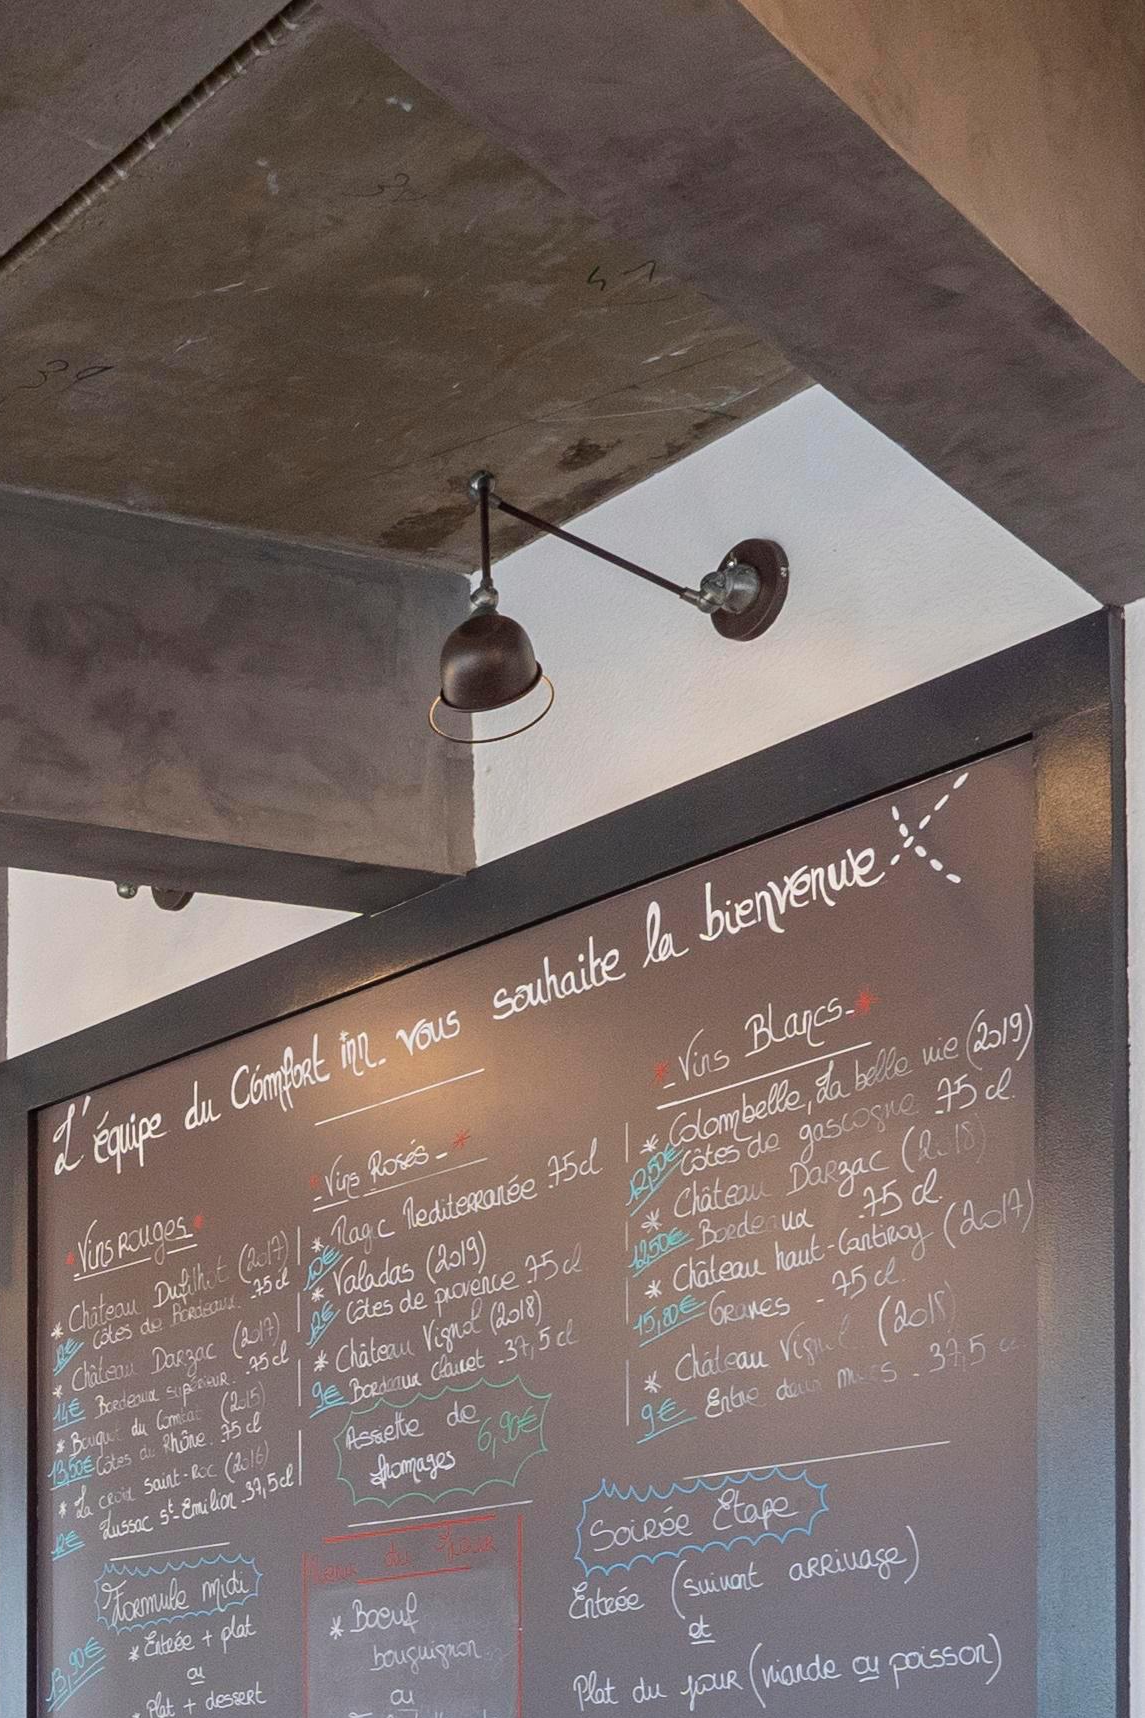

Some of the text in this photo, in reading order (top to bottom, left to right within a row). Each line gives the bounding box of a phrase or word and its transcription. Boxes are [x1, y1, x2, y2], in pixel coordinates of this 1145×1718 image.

[53, 1096, 167, 1175] L'équipe
[185, 1081, 222, 1131] du
[231, 1034, 331, 1112] Comfort
[396, 1010, 461, 1056] vous
[492, 936, 627, 1020] souhaite
[643, 900, 689, 968] la
[699, 848, 885, 941] bienvenue
[678, 1029, 730, 1082] Vins
[855, 1047, 913, 1089] belle
[922, 1034, 959, 1067] vie
[325, 1139, 429, 1199] Vins Rosés
[680, 1141, 741, 1176] Côtes
[747, 1130, 779, 1157] de
[674, 1176, 771, 1219] Château
[78, 1219, 114, 1273] Vins
[333, 1257, 415, 1296] Valadas
[672, 1257, 767, 1293] Château
[68, 1293, 141, 1333] Château
[346, 1299, 394, 1325] Côtes
[399, 1290, 428, 1313] de
[71, 1356, 137, 1391] Château
[335, 1336, 416, 1373] Château
[675, 1343, 769, 1382] Château
[131, 1418, 148, 1437] du
[345, 1400, 480, 1450] Assiette de
[370, 1449, 456, 1489] fromages
[99, 1510, 154, 1540] Lussac
[589, 1506, 694, 1552] Soirée
[202, 1569, 250, 1612] midi
[568, 1581, 645, 1620] Entrée
[349, 1592, 419, 1634] Boeuf
[688, 1614, 712, 1639] et
[144, 1630, 195, 1657] Entrée
[221, 1614, 257, 1654] plat
[186, 1666, 206, 1680] ou
[573, 1671, 619, 1711] Plat
[633, 1675, 667, 1703] du
[681, 1669, 743, 1711] jour
[853, 1656, 879, 1675] ou
[205, 1681, 267, 1711] dessert
[390, 1689, 414, 1705] ou
